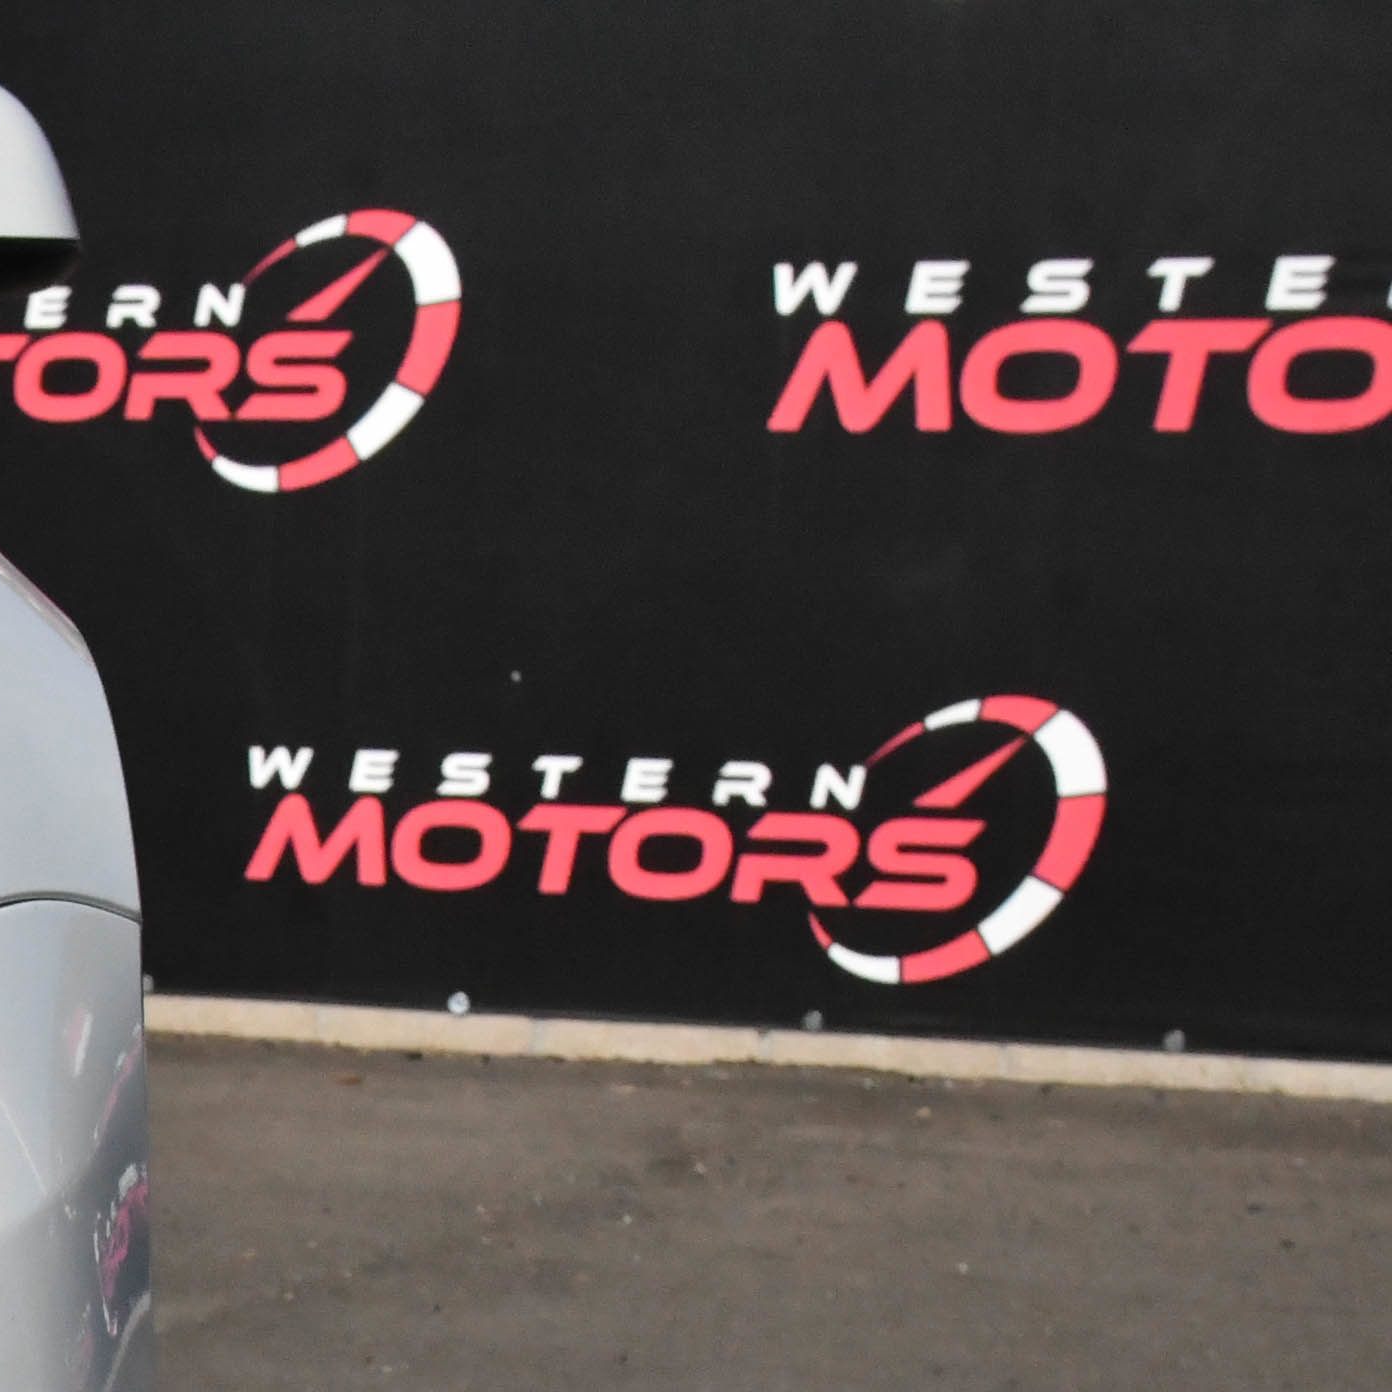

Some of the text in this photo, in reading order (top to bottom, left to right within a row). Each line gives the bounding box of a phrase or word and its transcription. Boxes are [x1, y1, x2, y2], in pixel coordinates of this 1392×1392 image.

[774, 256, 1392, 316] WESTE
[767, 316, 1392, 434] MOTO
[249, 746, 866, 810] WESTERN
[245, 793, 985, 911] MOTORS
